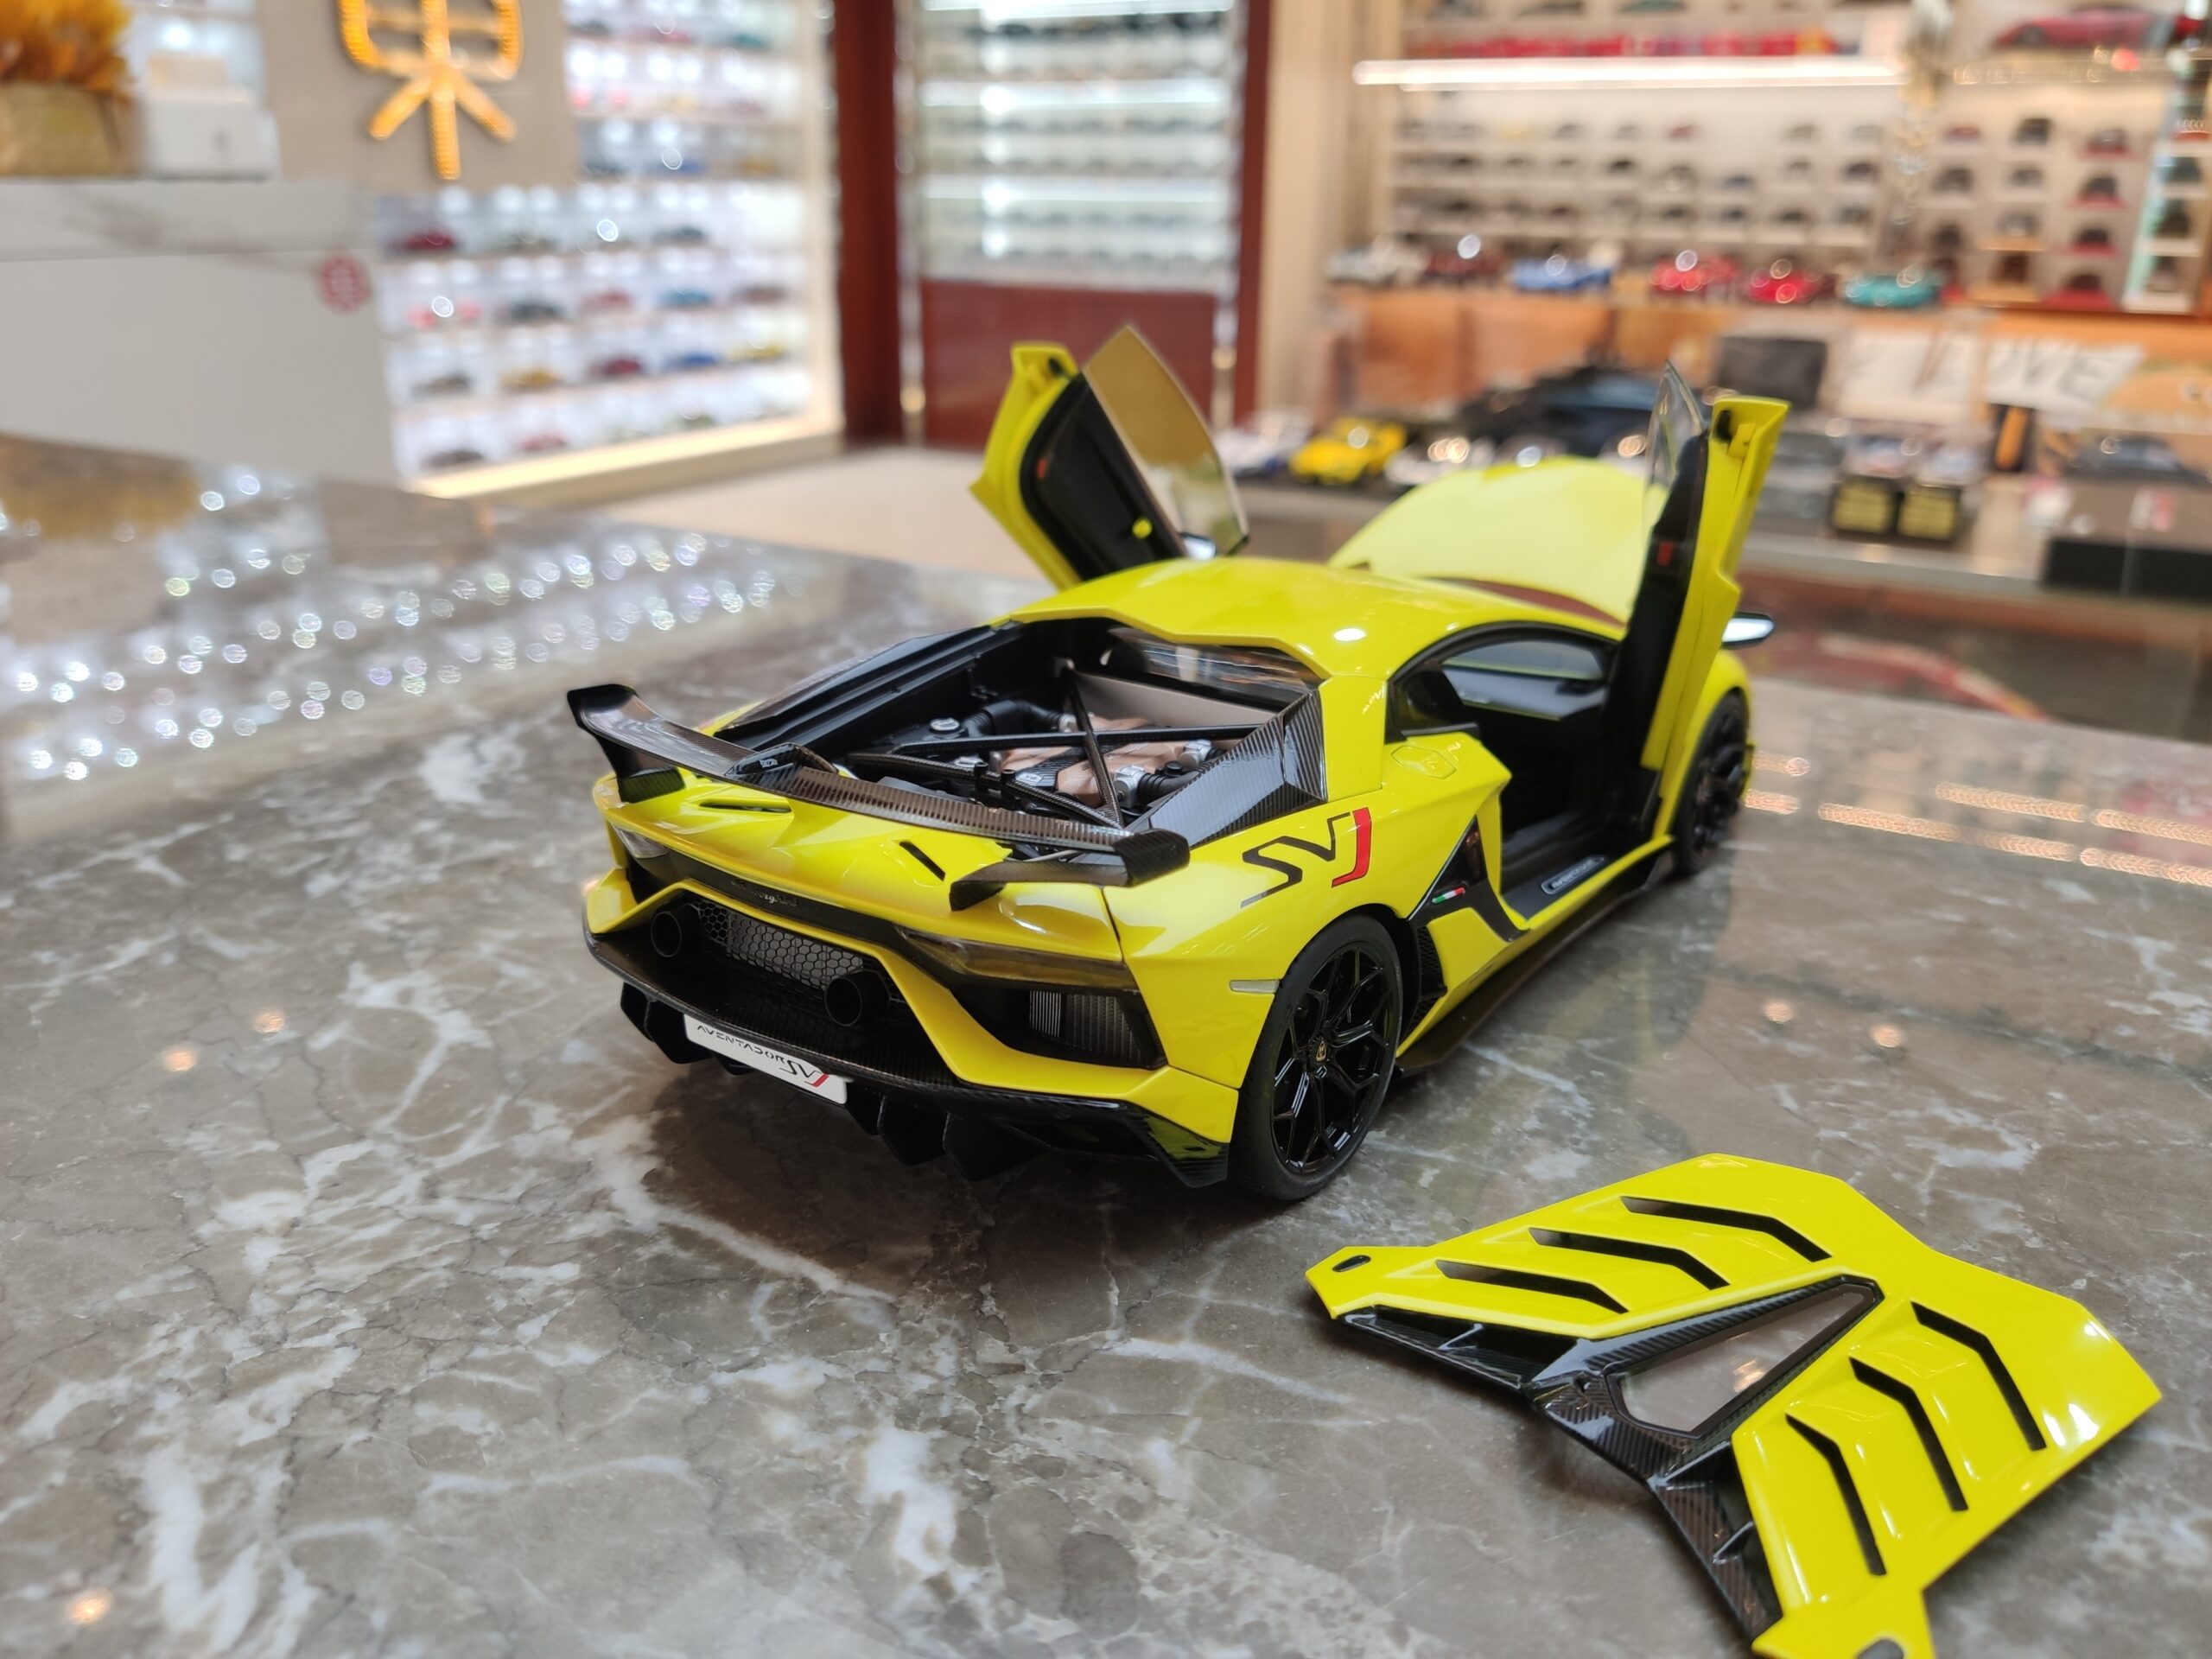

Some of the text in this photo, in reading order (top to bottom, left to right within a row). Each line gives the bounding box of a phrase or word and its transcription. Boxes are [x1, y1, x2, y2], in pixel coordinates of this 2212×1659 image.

[1240, 806, 1372, 908] SVJ
[696, 1025, 830, 1088] AVENTADOR SVJ
